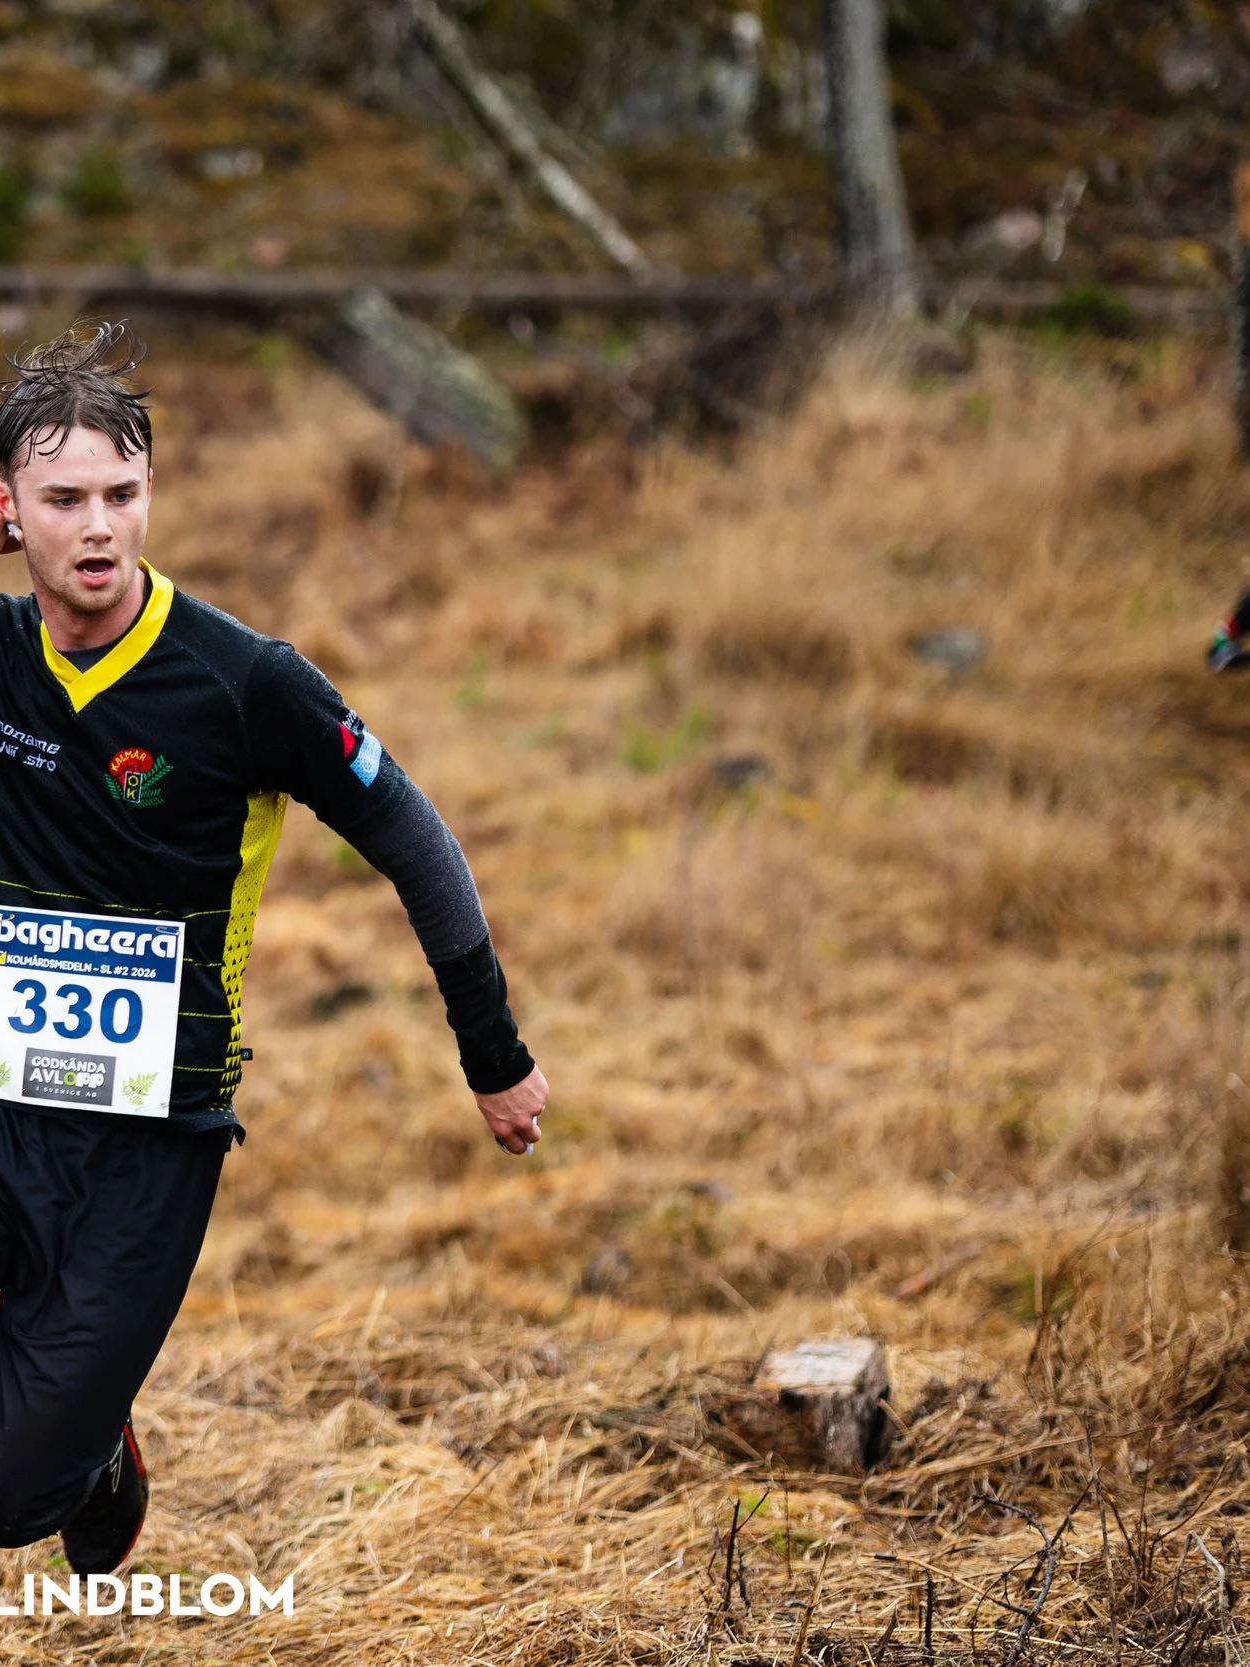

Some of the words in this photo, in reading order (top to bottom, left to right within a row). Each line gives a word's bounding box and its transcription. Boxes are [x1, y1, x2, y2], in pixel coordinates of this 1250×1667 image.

[110, 749, 147, 772] KALMAR
[6, 953, 92, 973] KOLMÅRDSMEDELN
[100, 964, 113, 975] SL
[114, 965, 129, 976] #2
[131, 966, 157, 978] 2026
[7, 978, 143, 1044] 330
[31, 1055, 106, 1074] GODKÄNDA
[43, 1086, 81, 1096] SVERIGE
